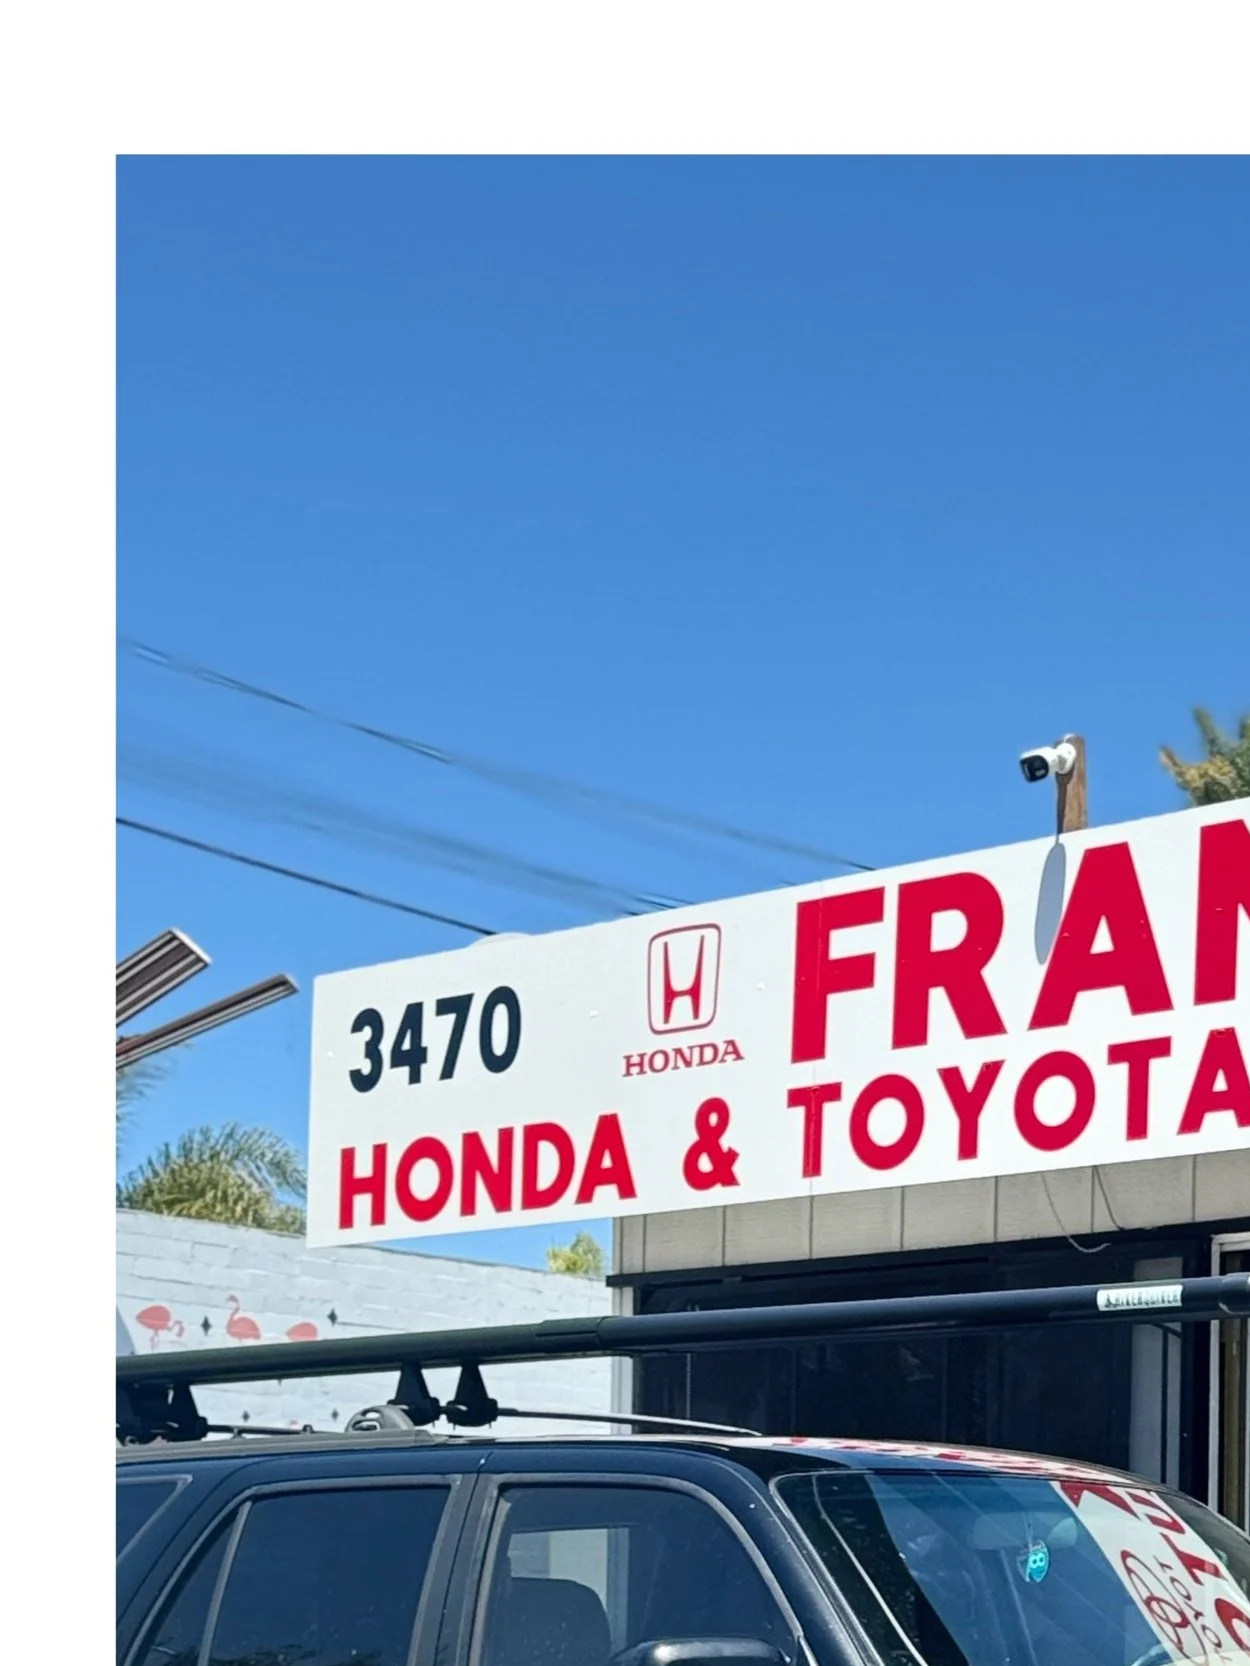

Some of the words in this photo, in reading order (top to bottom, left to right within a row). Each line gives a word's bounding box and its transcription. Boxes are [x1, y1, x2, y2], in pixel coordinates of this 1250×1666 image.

[349, 986, 521, 1093] 3470
[622, 1039, 745, 1077] HONDA
[339, 1113, 637, 1230] HONDA
[682, 1097, 741, 1192] &
